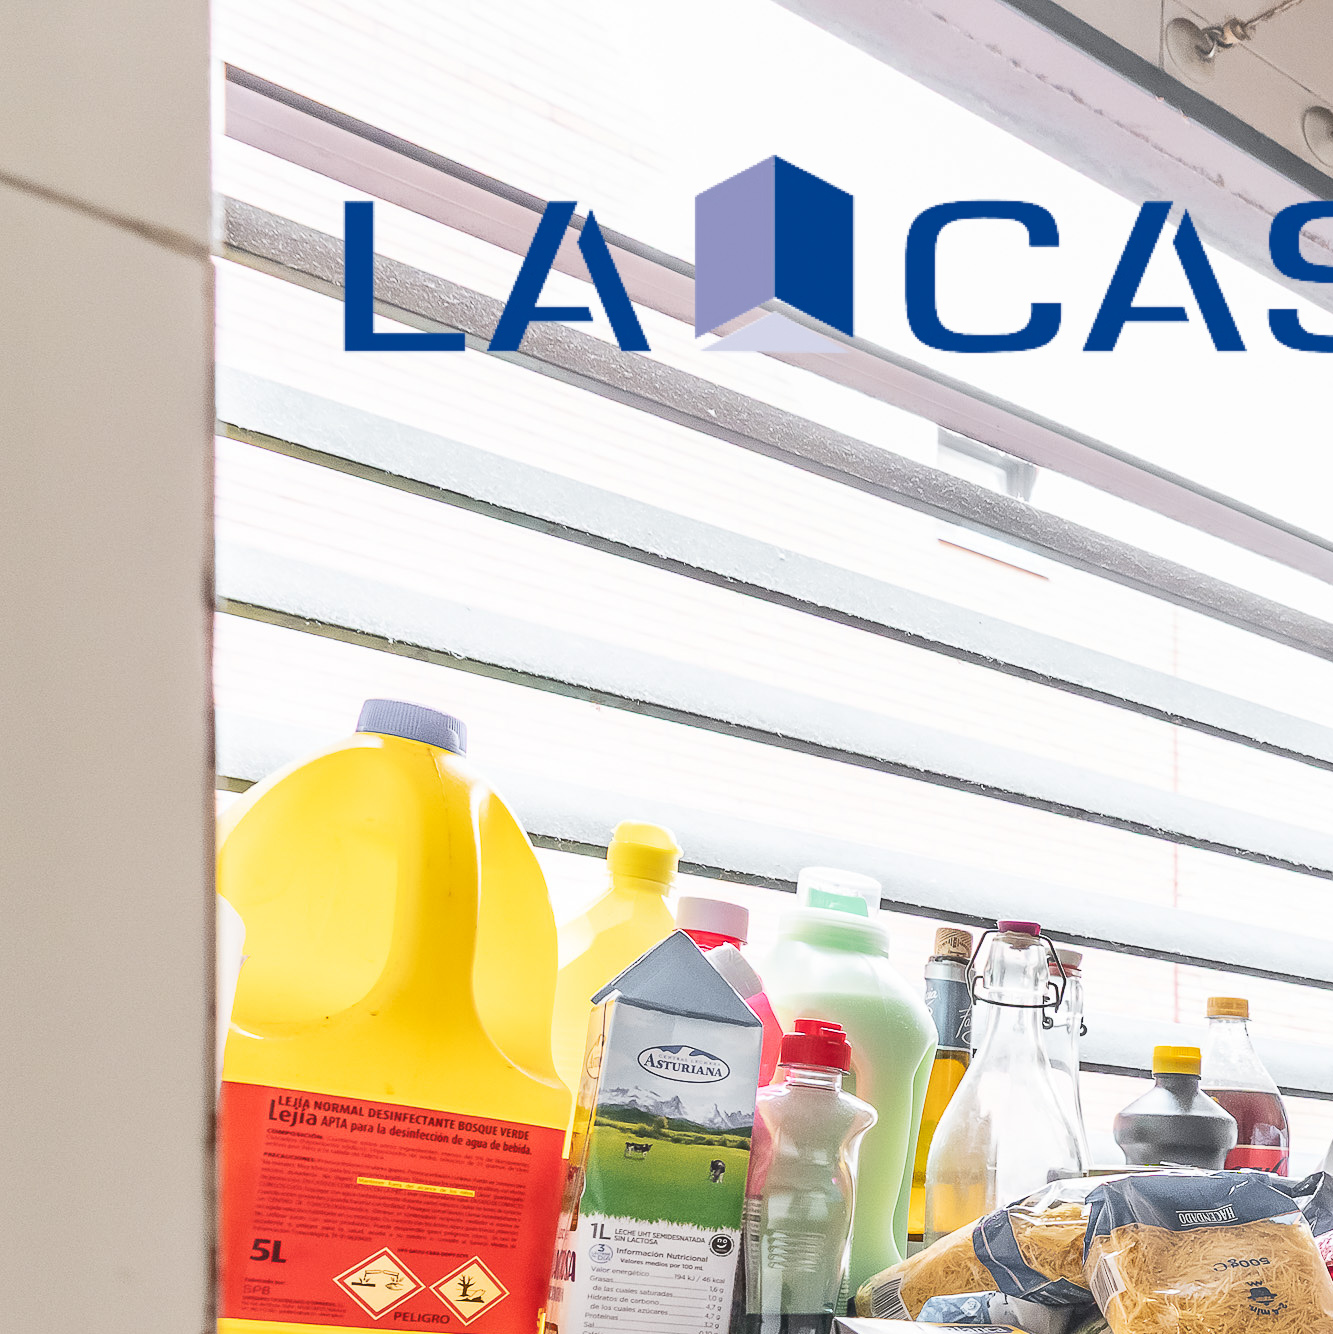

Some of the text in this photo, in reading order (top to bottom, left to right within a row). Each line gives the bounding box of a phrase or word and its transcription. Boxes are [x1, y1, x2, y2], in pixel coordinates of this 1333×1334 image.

[644, 1054, 722, 1077] ASTURIANA
[278, 1095, 529, 1140] LEJÍA NORMAL DESINFECTANTE BOSQUE VERDE
[269, 1099, 532, 1155] Lejía APTA para la desinfección de agua de bebida.
[1178, 1206, 1236, 1225] HACENDADO
[591, 1223, 611, 1240] 1L
[615, 1229, 635, 1237] LECHE
[653, 1232, 705, 1243] SEMIDESNATADA
[627, 1237, 658, 1245] LACTOSA
[250, 1238, 287, 1264] 5L
[616, 1247, 708, 1262] Información Nutricional
[393, 1311, 450, 1324] PELIGRO
